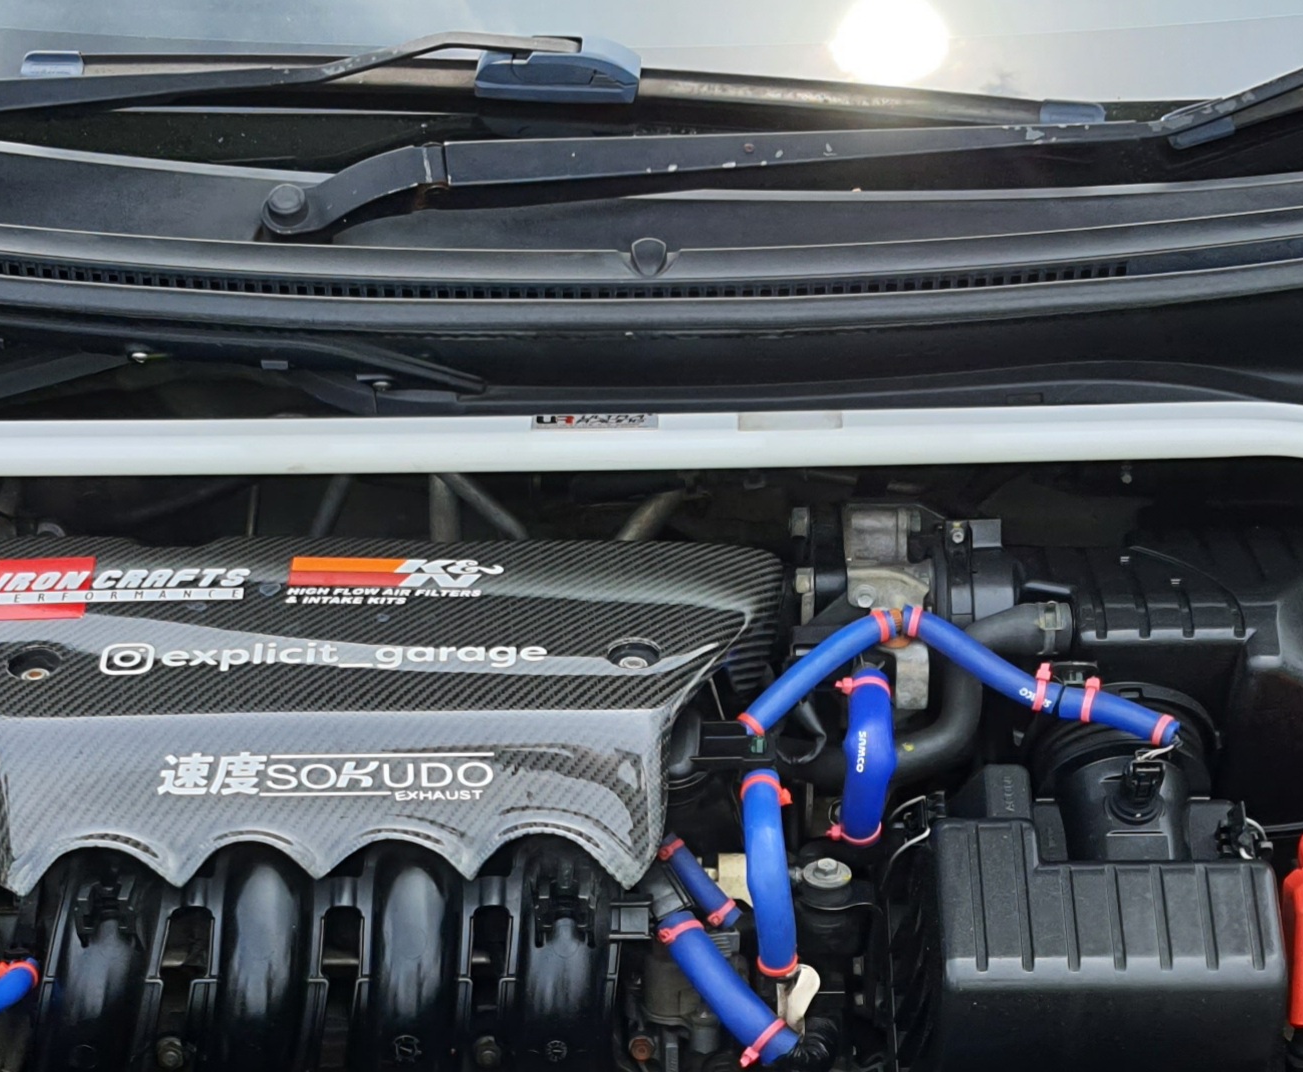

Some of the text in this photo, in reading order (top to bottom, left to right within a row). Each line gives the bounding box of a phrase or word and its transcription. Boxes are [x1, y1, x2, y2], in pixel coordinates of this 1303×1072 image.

[91, 568, 251, 590] CRAFTS
[394, 559, 504, 588] K&N
[286, 588, 482, 597] HIGH FLOW AIR FILTERS
[302, 597, 362, 605] INTAKE
[367, 597, 407, 605] KITS
[161, 642, 548, 671] explicit_garage
[1019, 687, 1053, 708] SCO
[856, 730, 867, 773] SAMCO
[157, 752, 268, 796] 速度
[266, 761, 494, 789] SOKUDO
[395, 790, 483, 801] EXHAUST
